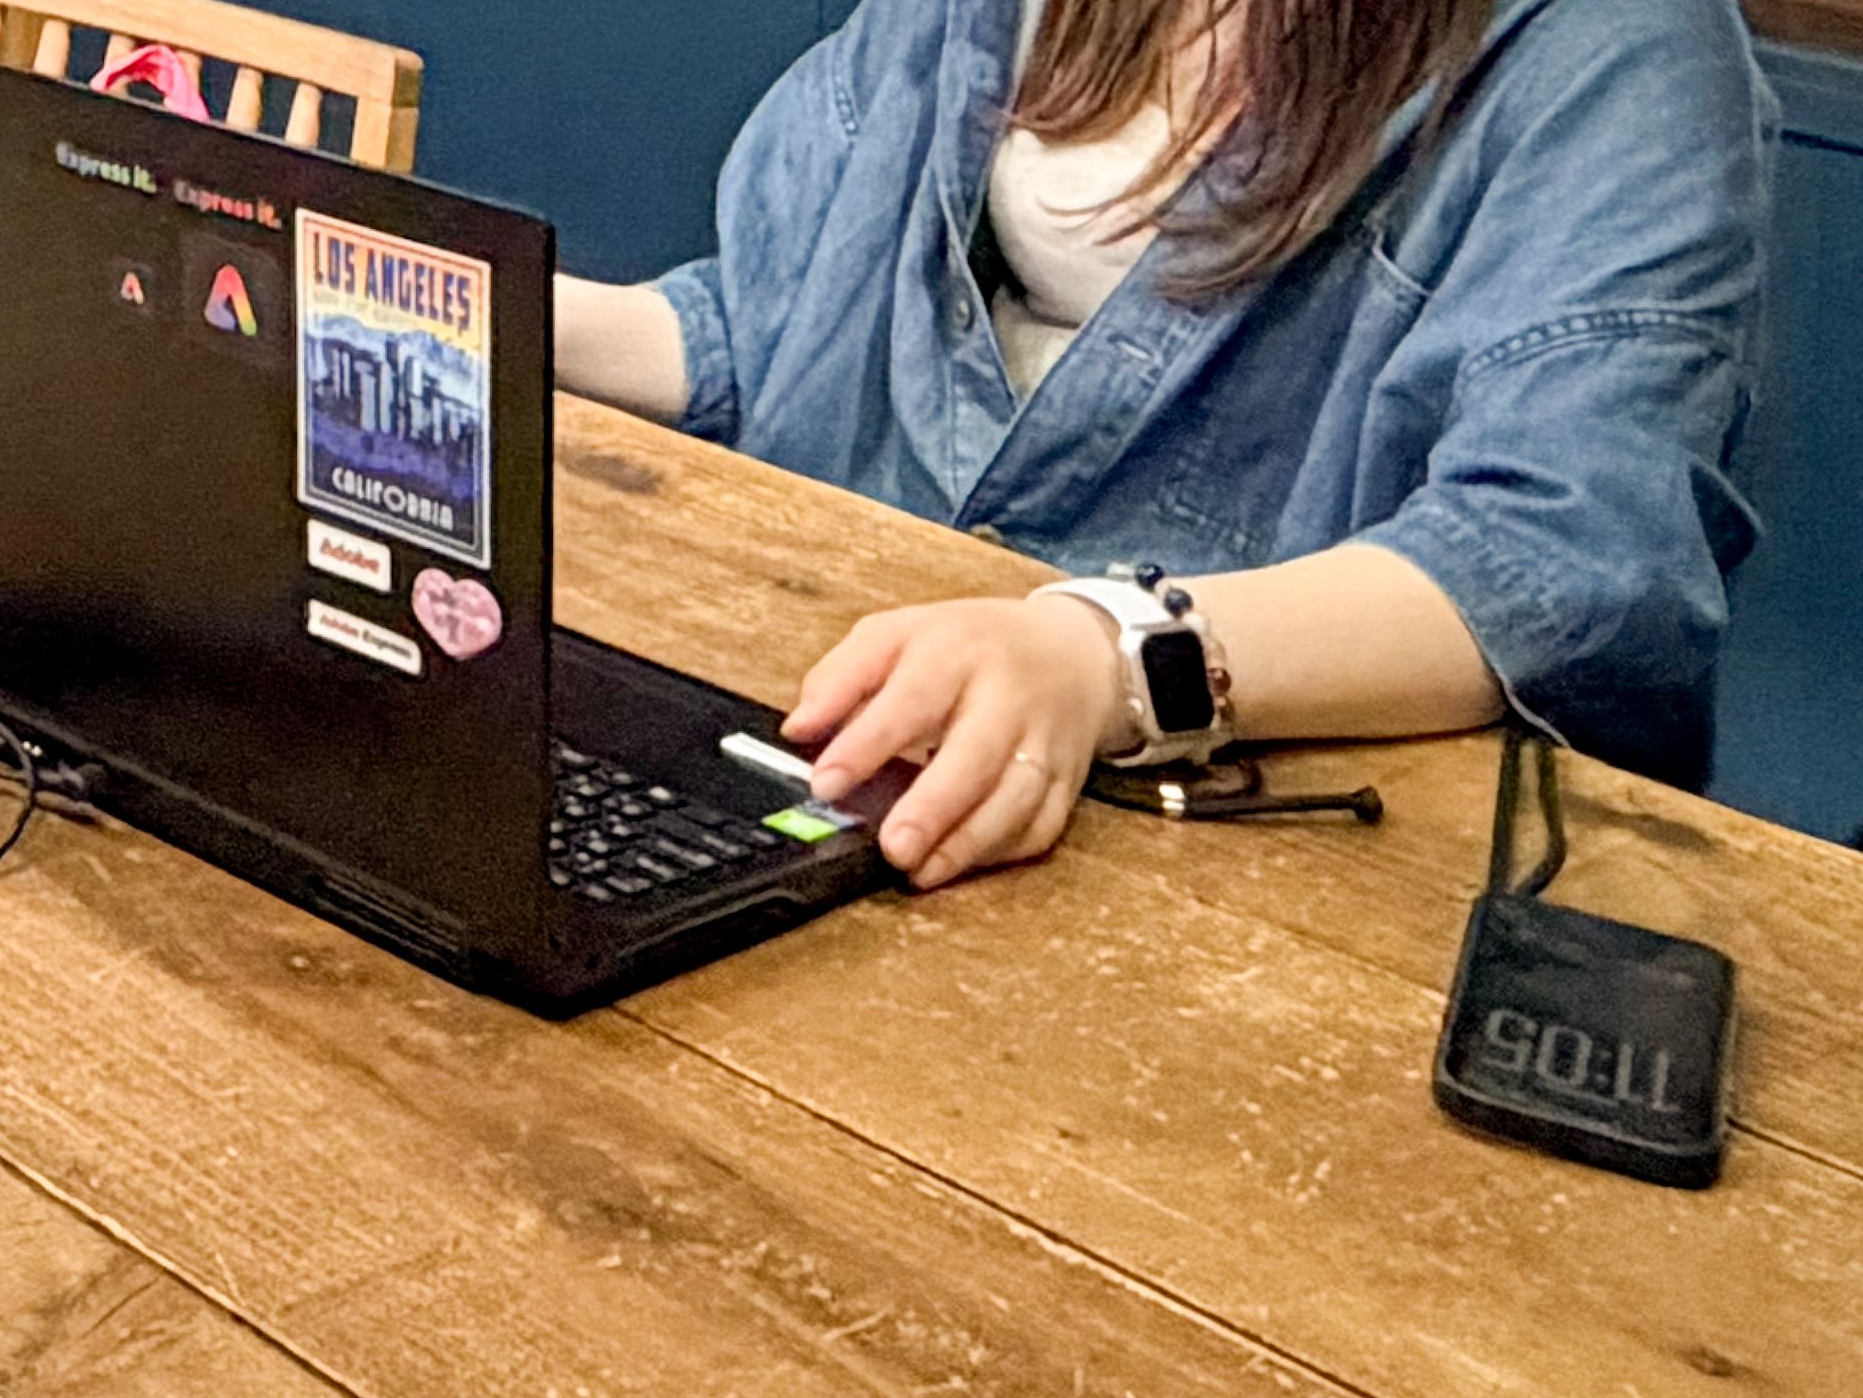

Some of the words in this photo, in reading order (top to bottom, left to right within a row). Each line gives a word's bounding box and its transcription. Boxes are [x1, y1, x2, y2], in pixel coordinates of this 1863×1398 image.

[313, 232, 356, 295] LOS
[364, 247, 471, 334] ANGELES
[331, 466, 455, 532] CALIFORNIA
